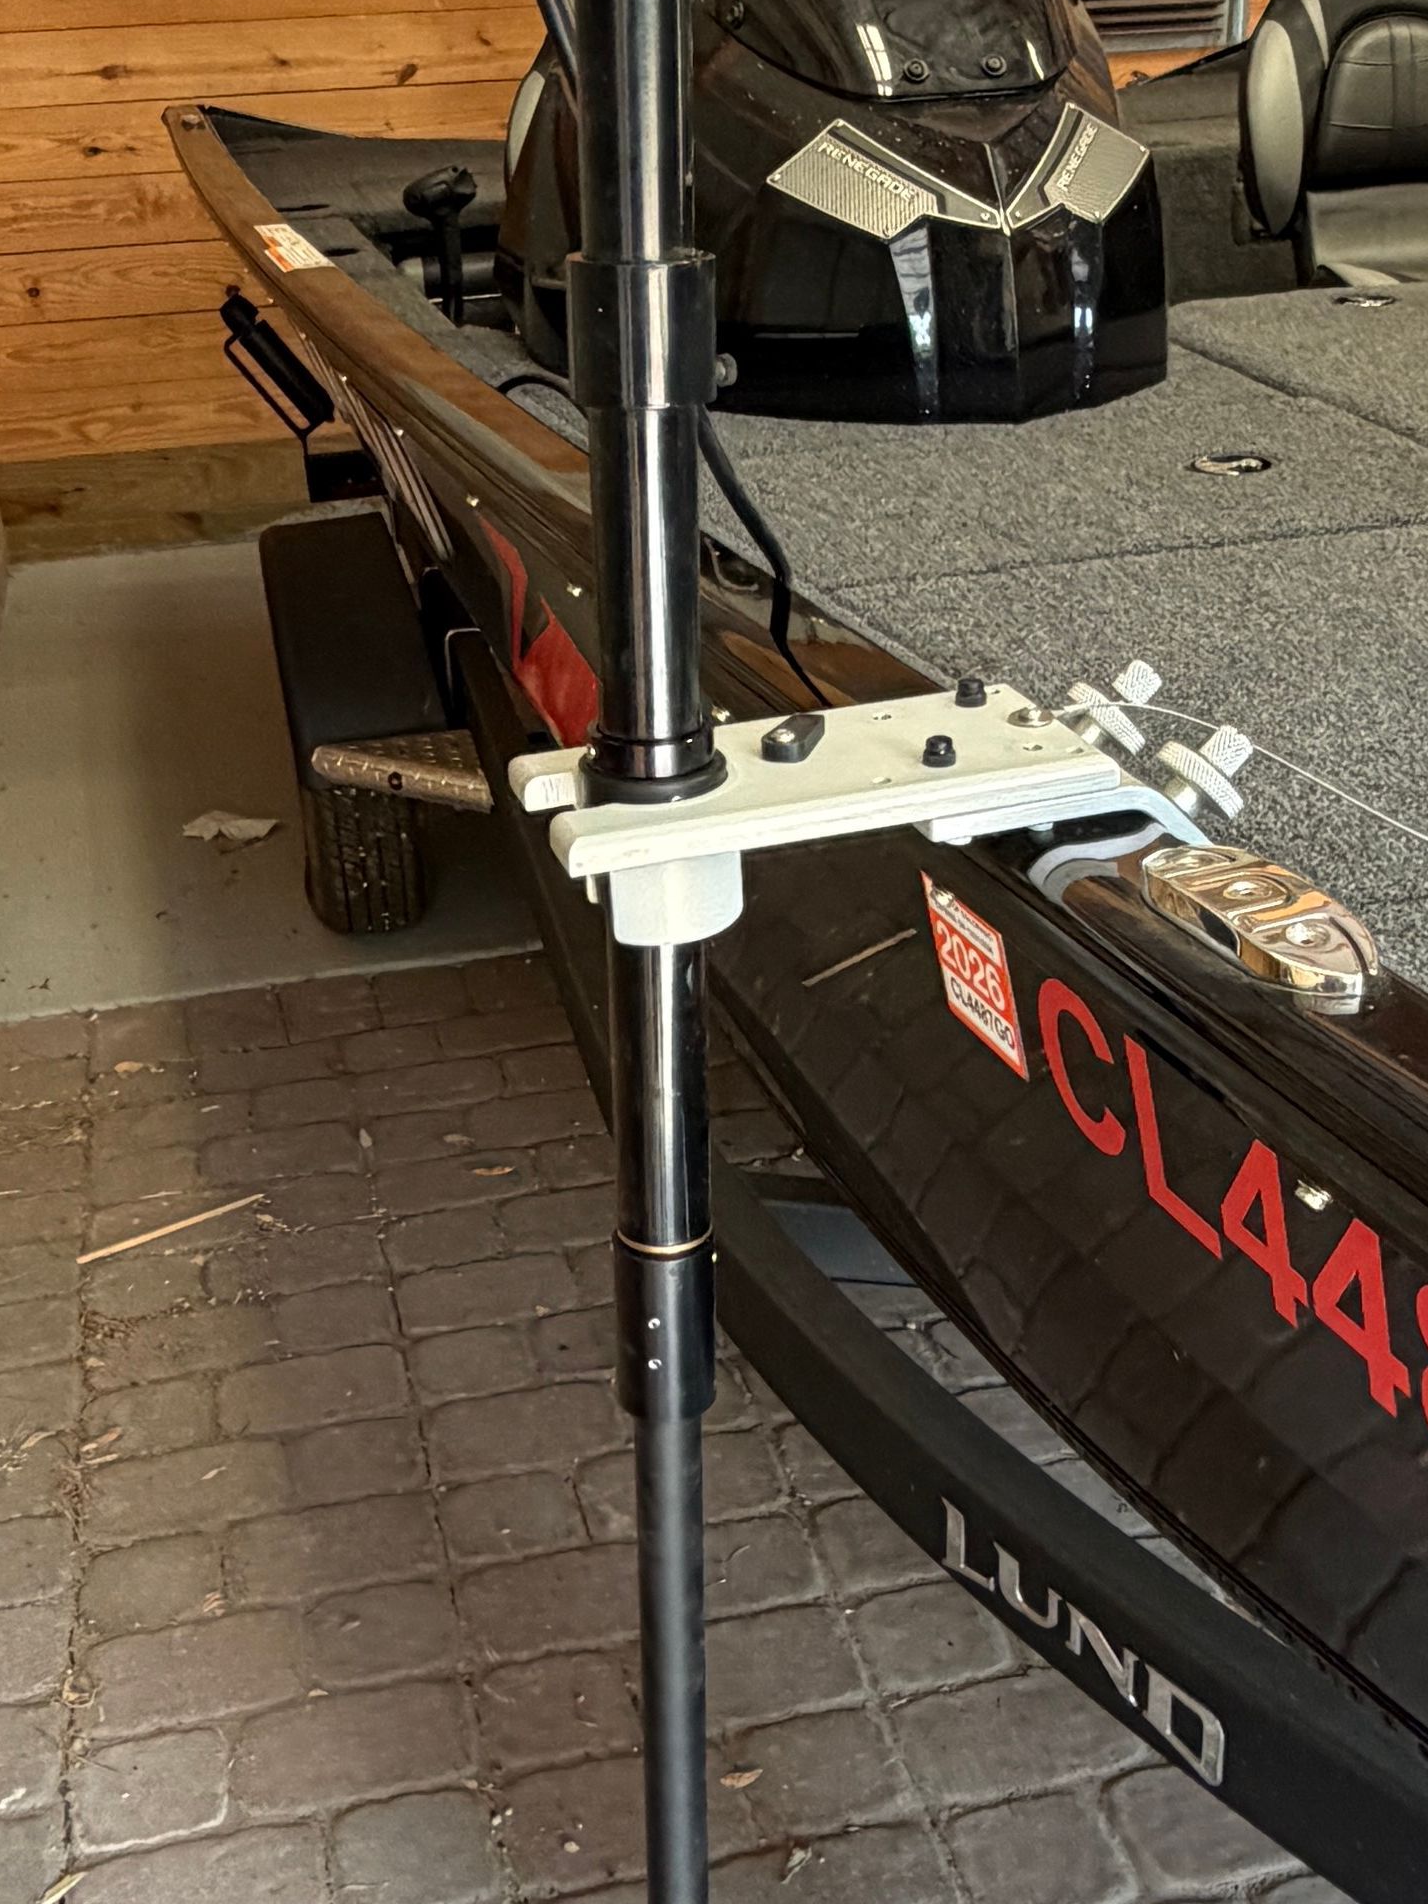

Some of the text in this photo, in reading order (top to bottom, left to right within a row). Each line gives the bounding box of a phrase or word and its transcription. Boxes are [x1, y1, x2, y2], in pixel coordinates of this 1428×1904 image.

[817, 141, 919, 202] RENEGADE
[1057, 122, 1098, 192] RENEGADE
[936, 919, 1006, 1011] 2026
[941, 1496, 1227, 1790] LUND
